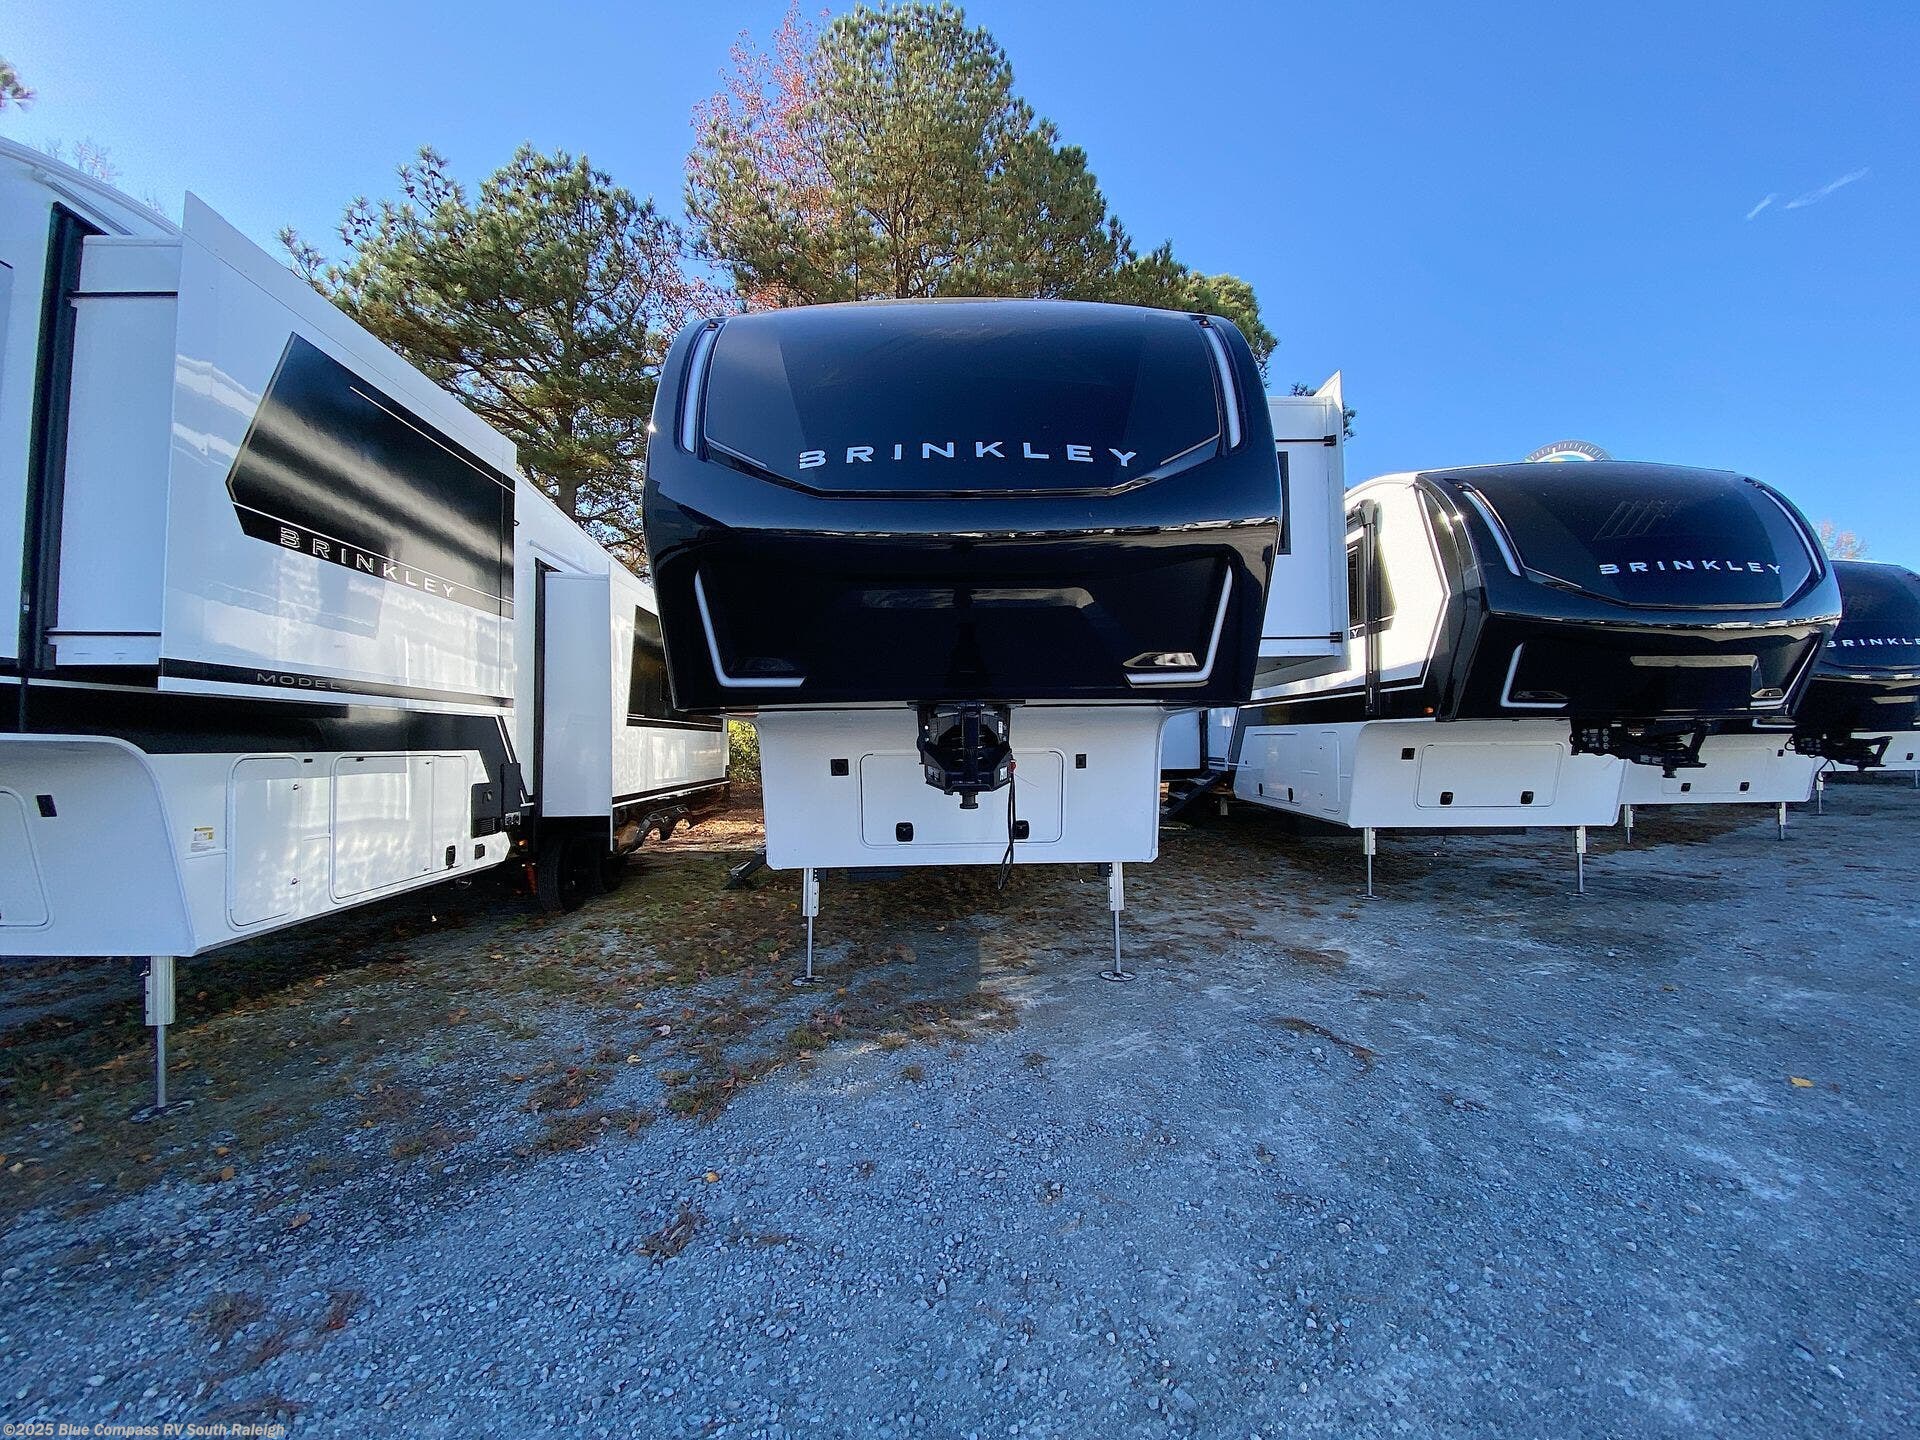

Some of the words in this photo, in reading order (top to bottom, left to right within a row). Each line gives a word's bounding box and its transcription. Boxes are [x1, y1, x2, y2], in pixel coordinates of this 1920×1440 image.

[799, 441, 1136, 469] BRINKLEY
[279, 526, 455, 598] BRINKLEY
[1599, 560, 1782, 575] BRINKLEY
[256, 672, 341, 690] MODEL
